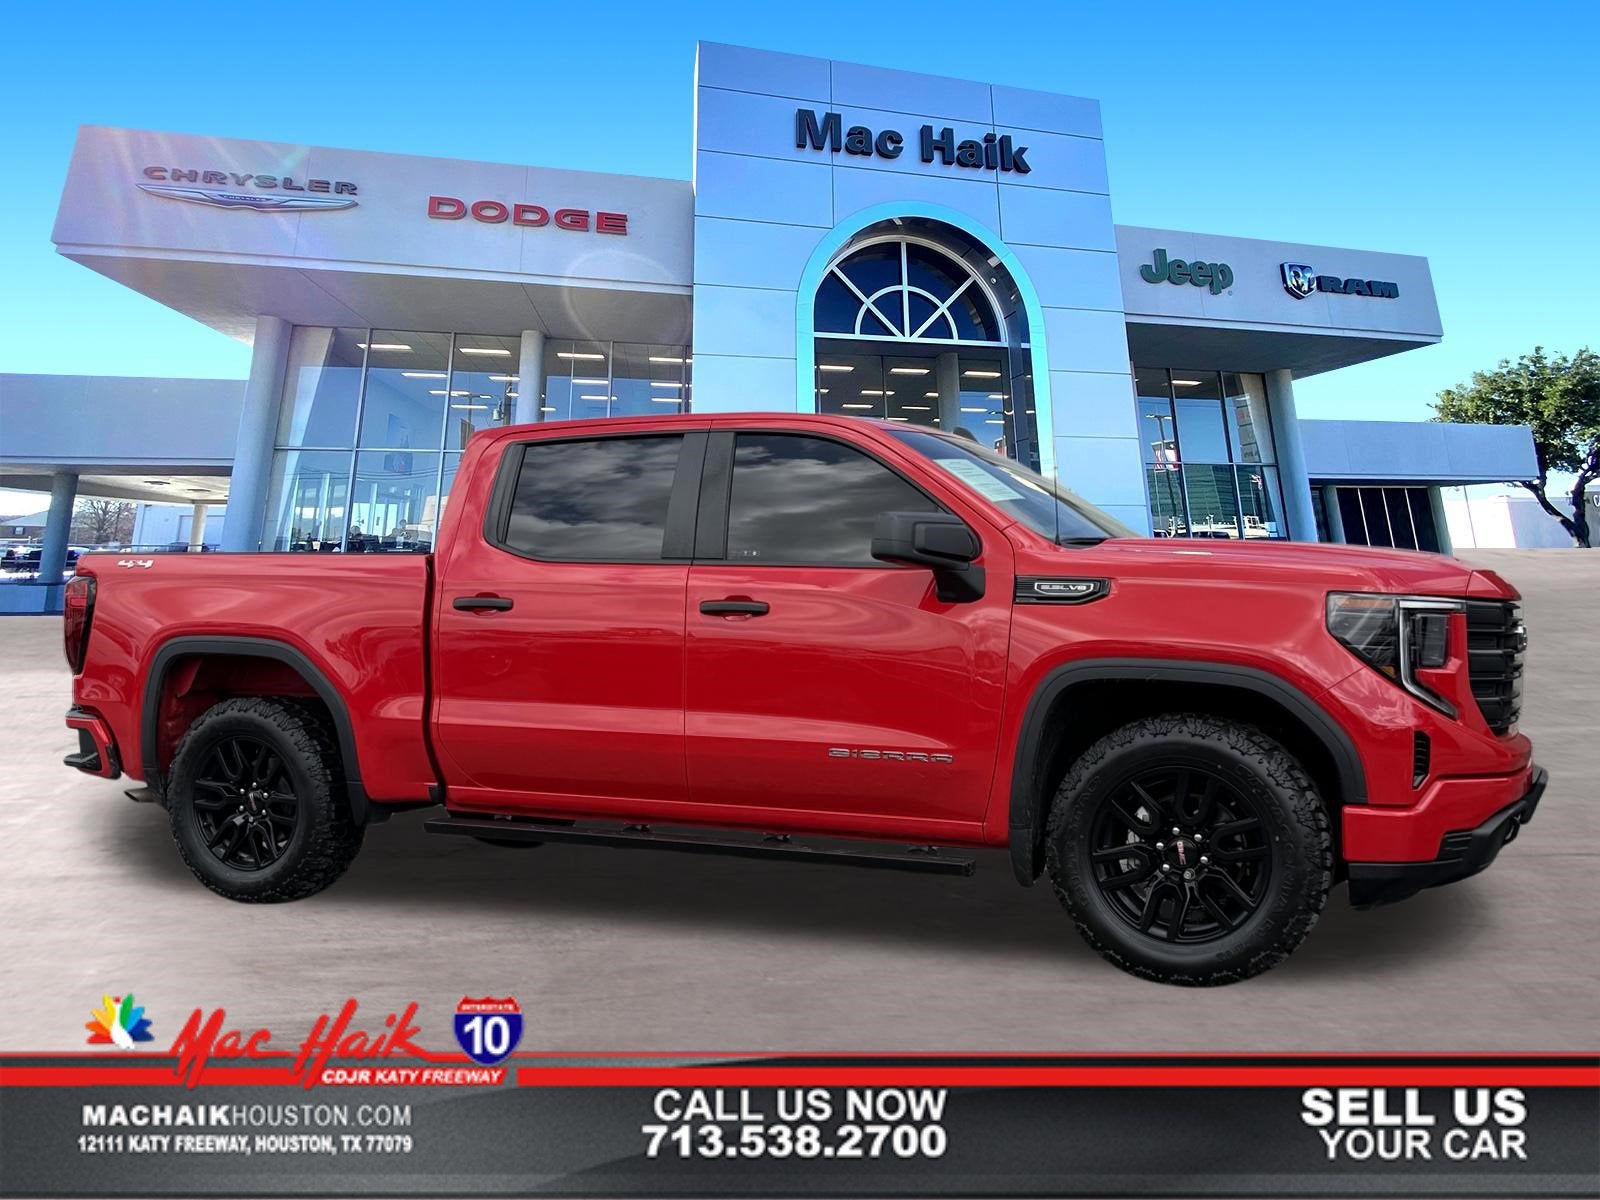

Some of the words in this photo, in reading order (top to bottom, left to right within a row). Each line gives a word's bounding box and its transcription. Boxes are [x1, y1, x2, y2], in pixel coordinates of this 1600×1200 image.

[796, 108, 903, 160] Mac
[920, 124, 1032, 175] Haik
[143, 166, 358, 196] CHRYSLER
[427, 195, 628, 236] DODGE
[1140, 248, 1234, 295] Jeep
[1316, 275, 1400, 299] RAM
[828, 747, 953, 763] SIERRA
